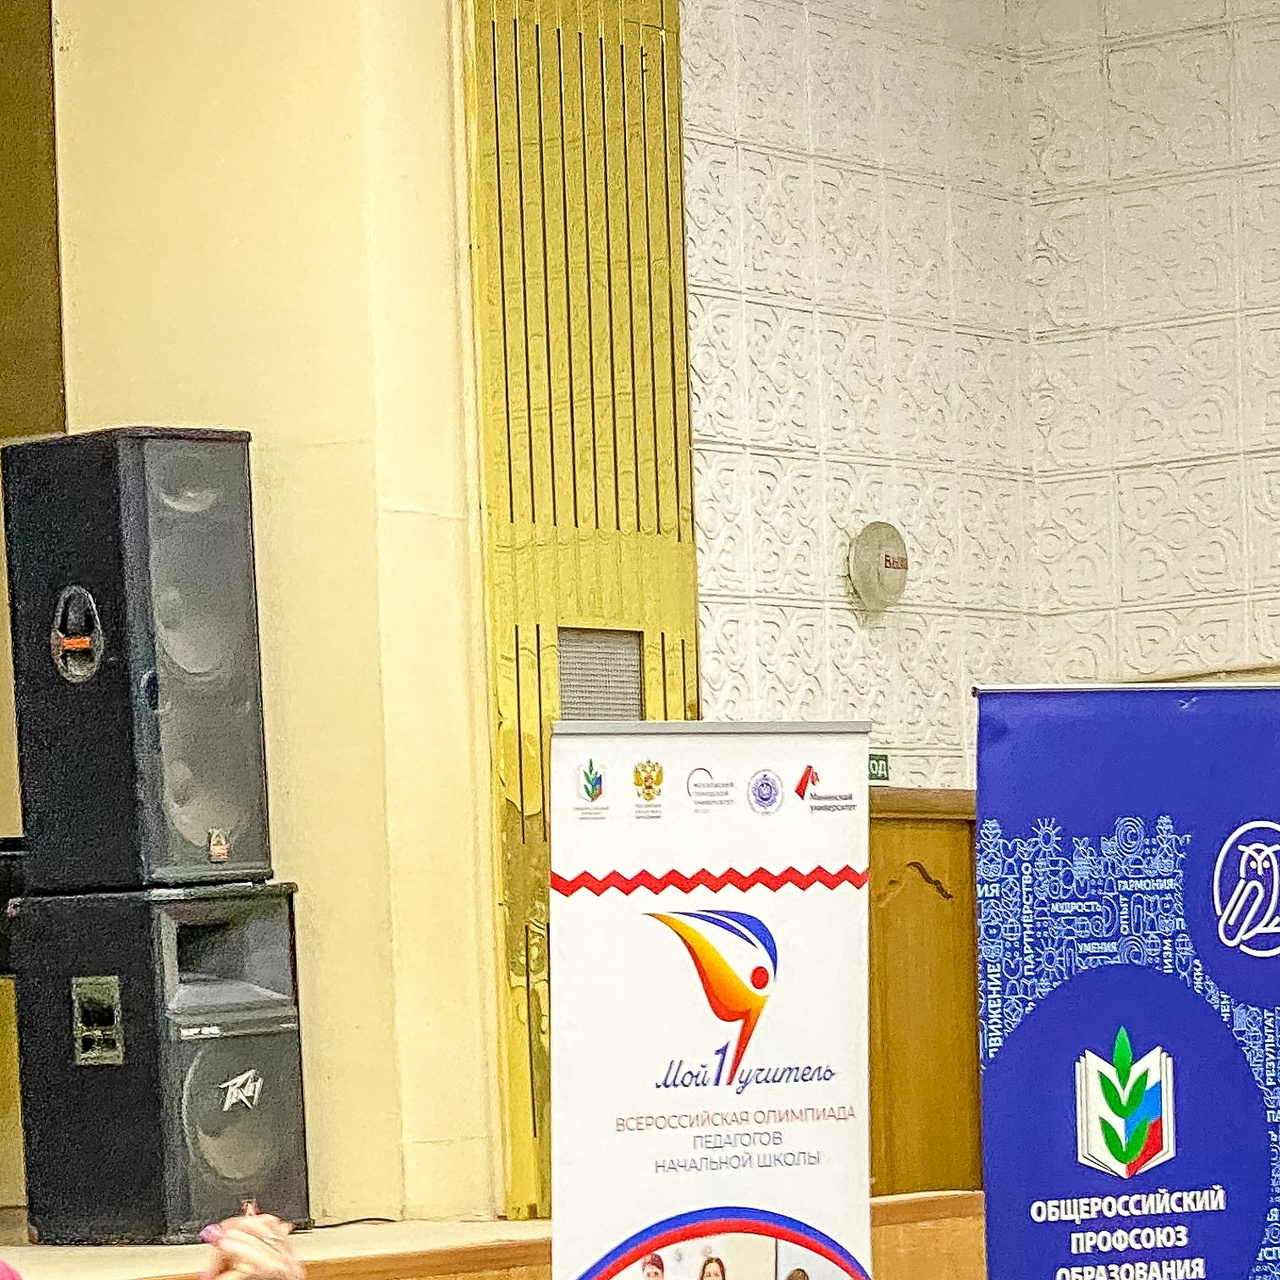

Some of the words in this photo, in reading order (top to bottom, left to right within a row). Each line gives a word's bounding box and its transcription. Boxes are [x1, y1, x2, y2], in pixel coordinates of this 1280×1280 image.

[1020, 862, 1036, 976] ПАРТНЕРСТВО
[654, 1060, 710, 1089] Мой
[735, 1065, 836, 1095] учитель
[615, 1110, 751, 1132] ВСЕРОССИЙСКАЯ
[753, 1105, 857, 1126] ОЛИМПИАДА
[693, 1131, 784, 1150] ПЕДАГОГОВ
[654, 1151, 754, 1174] НАЧАЛЬНОЙ
[756, 1149, 821, 1169] ШКОЛЫ
[1030, 1185, 1226, 1224] ОБЩЕРОССИЙСКИЙ
[1071, 1225, 1189, 1255] ПРОФСОЮЗ
